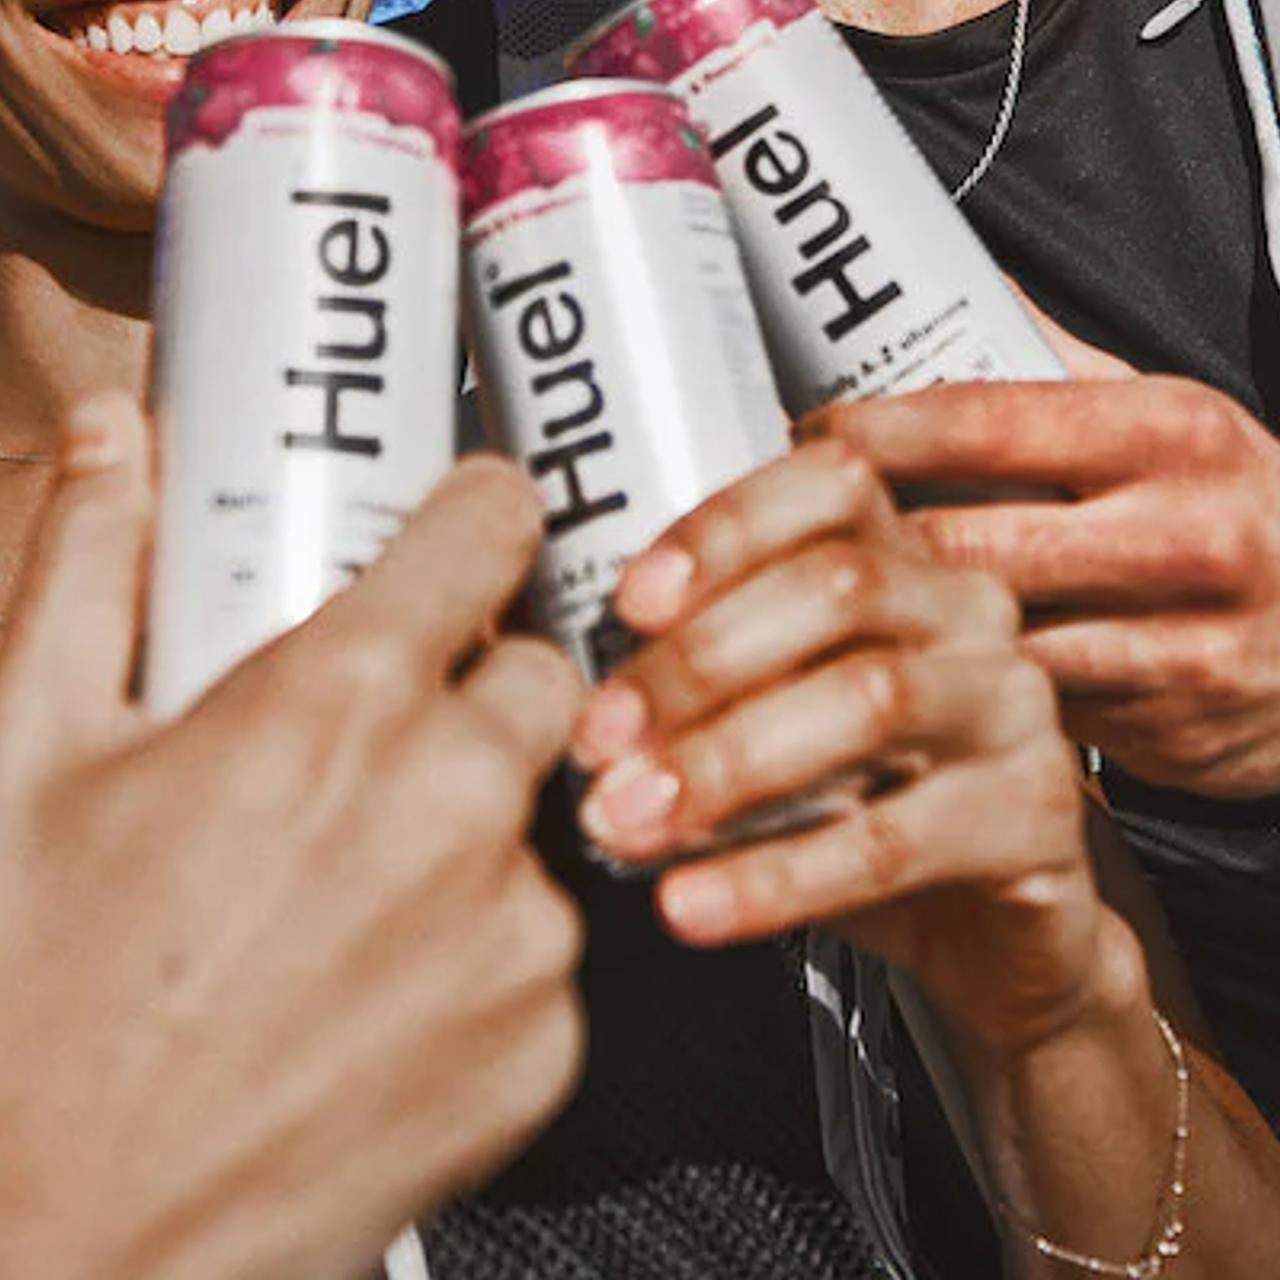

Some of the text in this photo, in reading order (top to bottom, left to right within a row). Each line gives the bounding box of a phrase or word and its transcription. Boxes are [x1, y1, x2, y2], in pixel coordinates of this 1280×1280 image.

[283, 190, 392, 458] Huel
[709, 103, 903, 344] Huel
[489, 260, 628, 536] Huel
